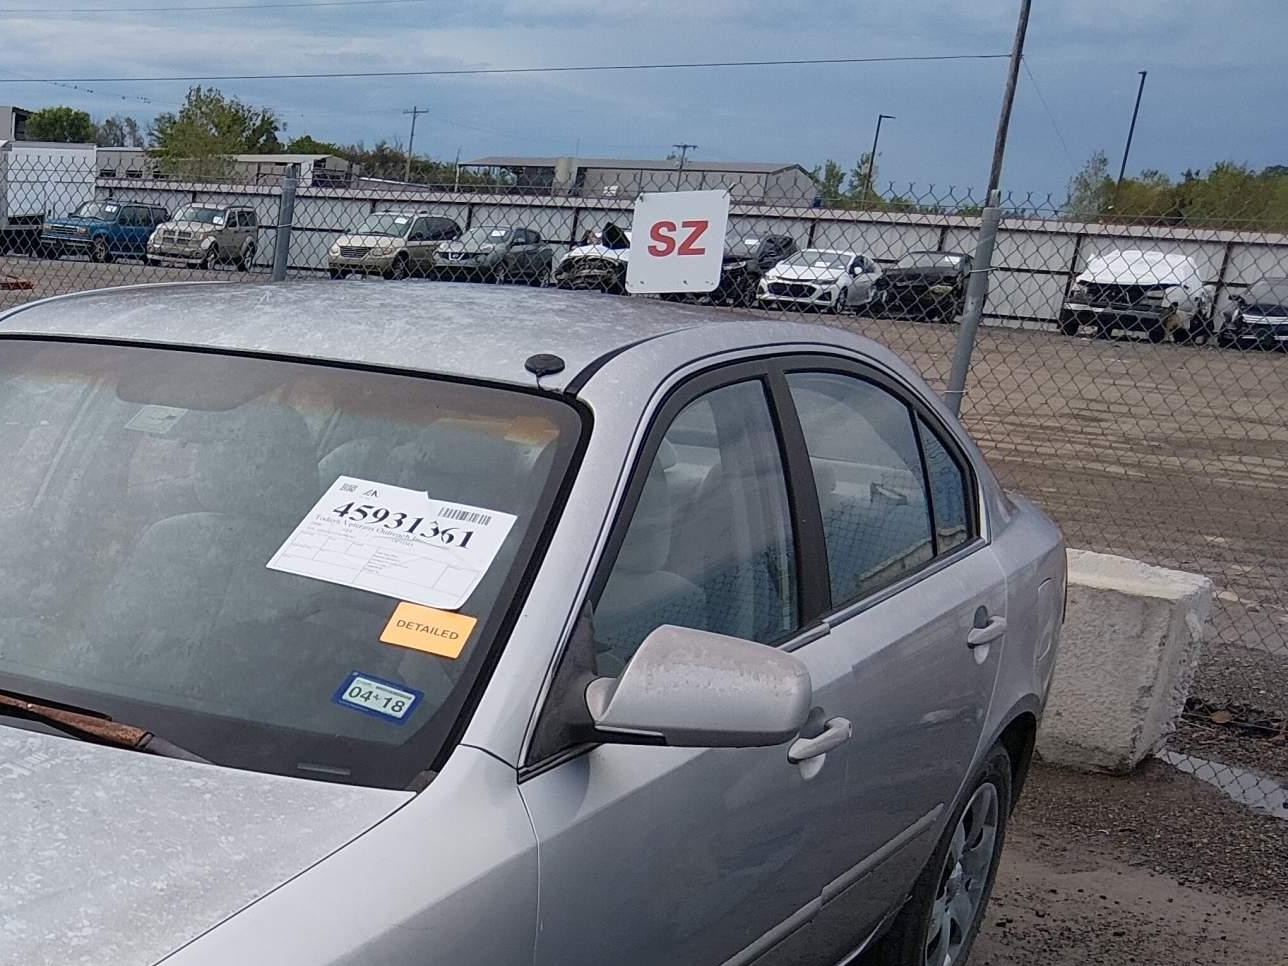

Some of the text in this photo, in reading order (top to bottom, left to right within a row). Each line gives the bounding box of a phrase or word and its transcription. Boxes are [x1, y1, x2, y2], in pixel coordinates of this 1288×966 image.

[647, 220, 709, 257] SZ
[333, 501, 474, 549] 45931361
[396, 619, 459, 640] DETAILED
